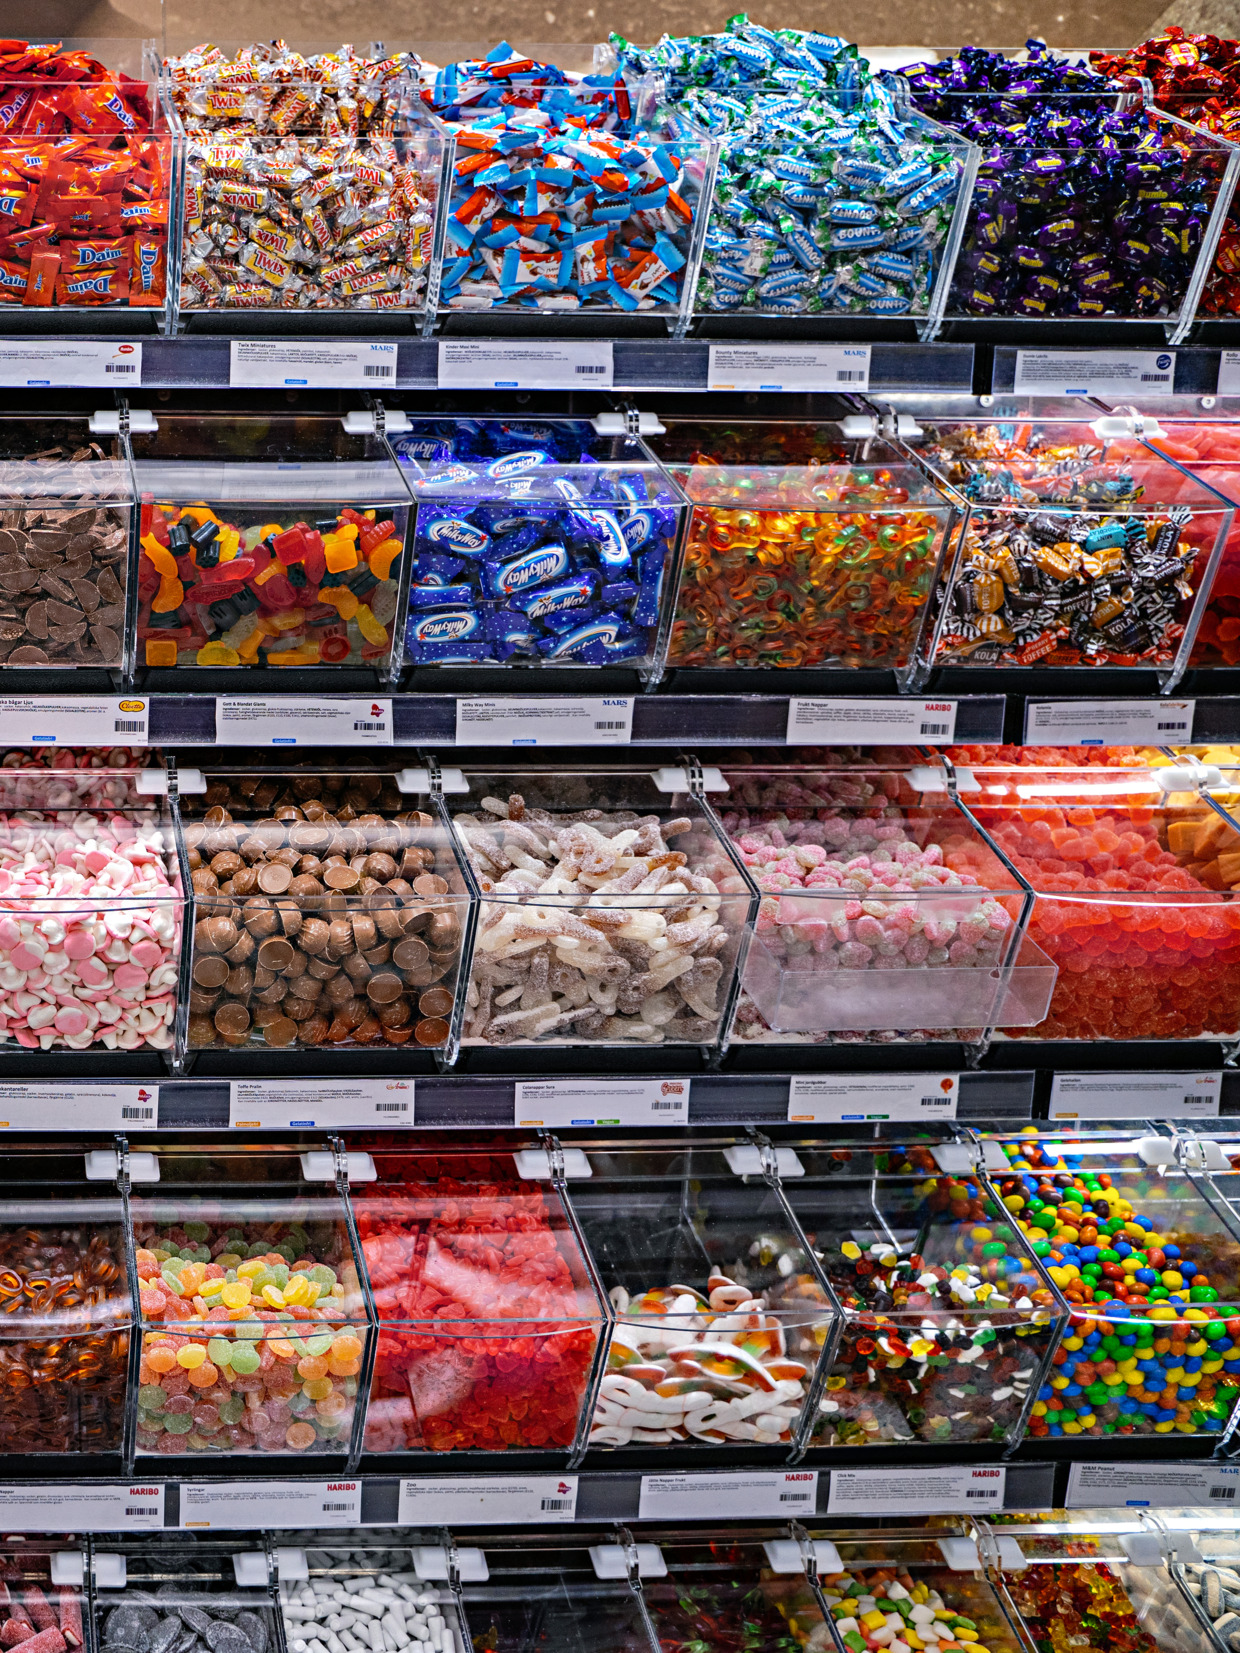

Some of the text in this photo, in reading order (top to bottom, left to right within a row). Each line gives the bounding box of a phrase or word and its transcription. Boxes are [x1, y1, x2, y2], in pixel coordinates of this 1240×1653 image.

[910, 177, 952, 208] BOUNTY
[79, 248, 122, 266] Daim
[140, 246, 158, 290] Daim
[68, 276, 112, 294] Daim
[438, 525, 481, 548] MilkyWay
[507, 554, 558, 579] MilkyWay
[422, 619, 468, 635] MilkyWay
[1110, 618, 1134, 636] KOLA
[974, 650, 997, 662] KOLA
[1022, 644, 1052, 664] TOFFEE
